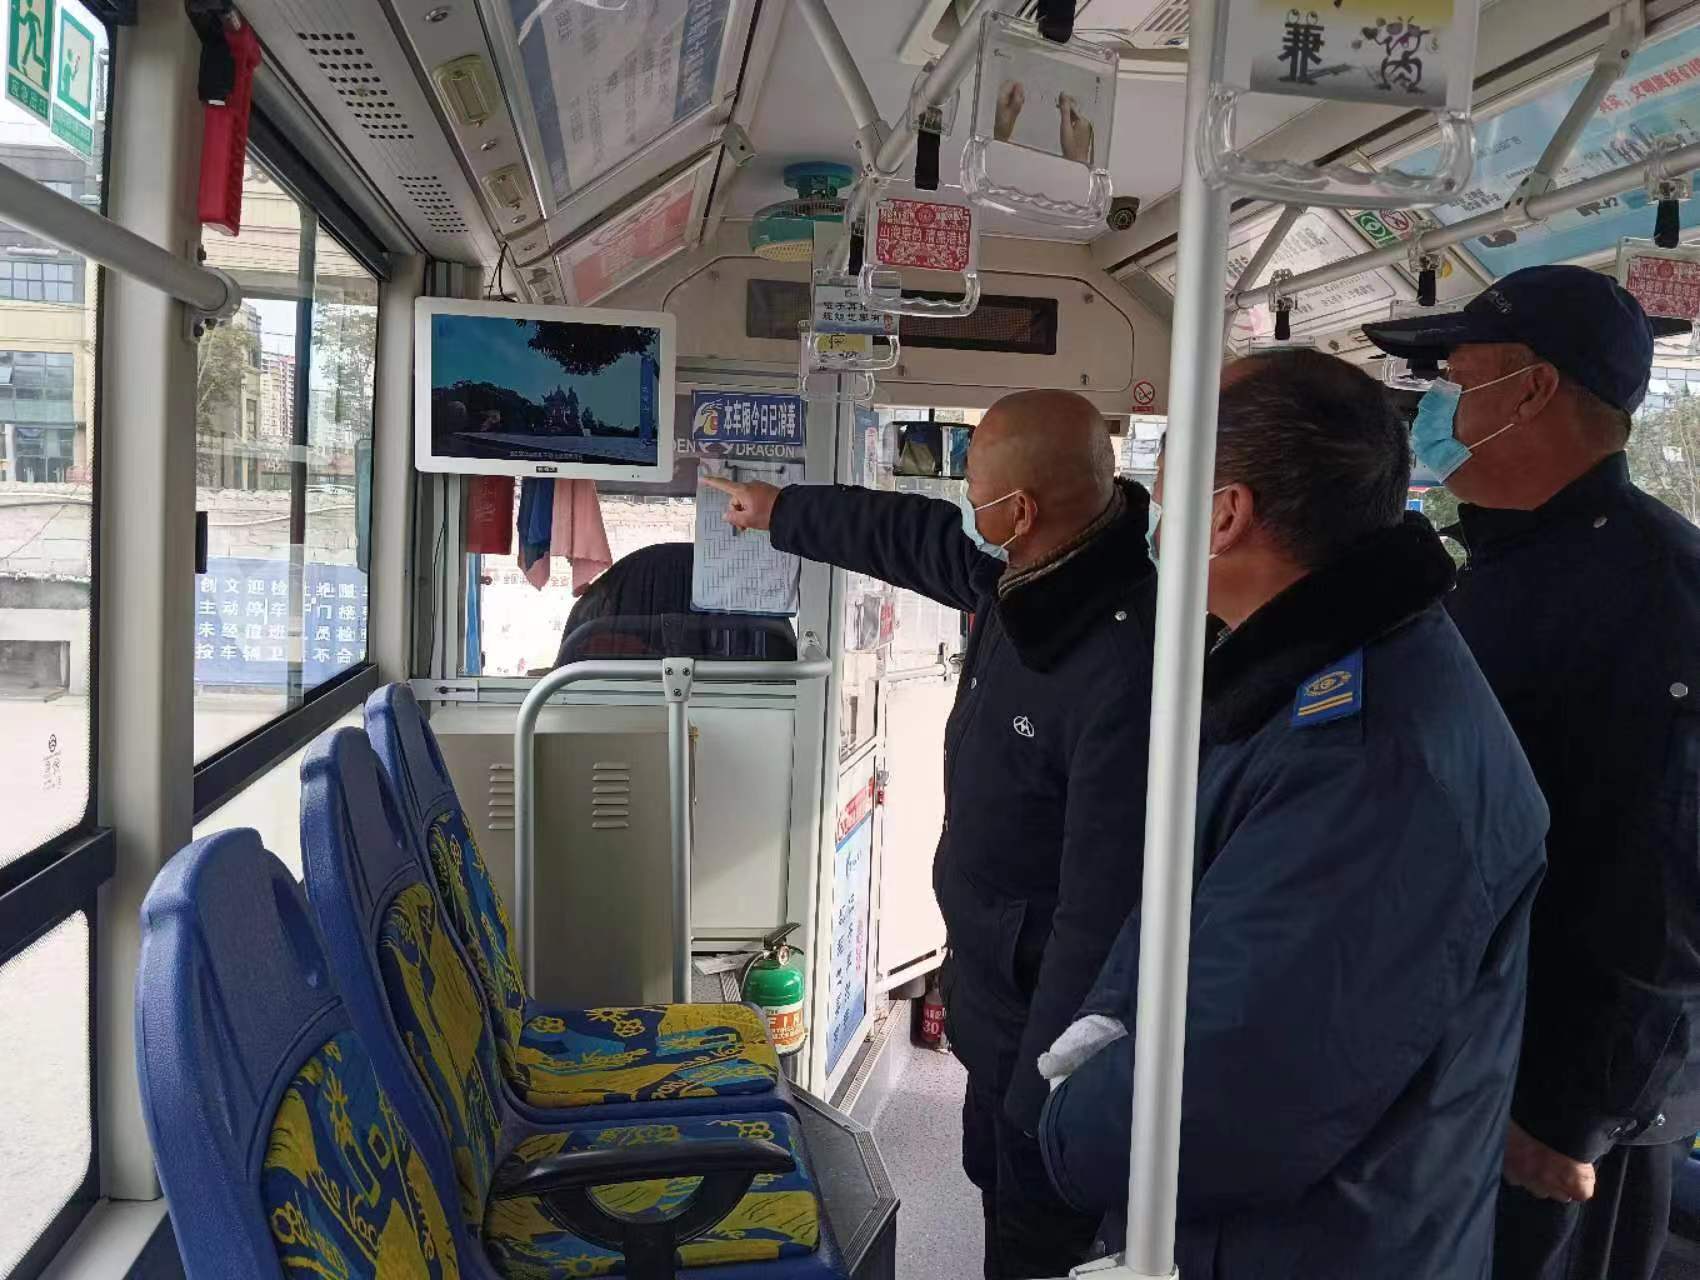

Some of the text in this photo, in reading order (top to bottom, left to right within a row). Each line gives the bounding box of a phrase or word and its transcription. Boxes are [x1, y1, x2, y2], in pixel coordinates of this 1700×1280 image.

[723, 399, 797, 438] 本车厢今日已消毒
